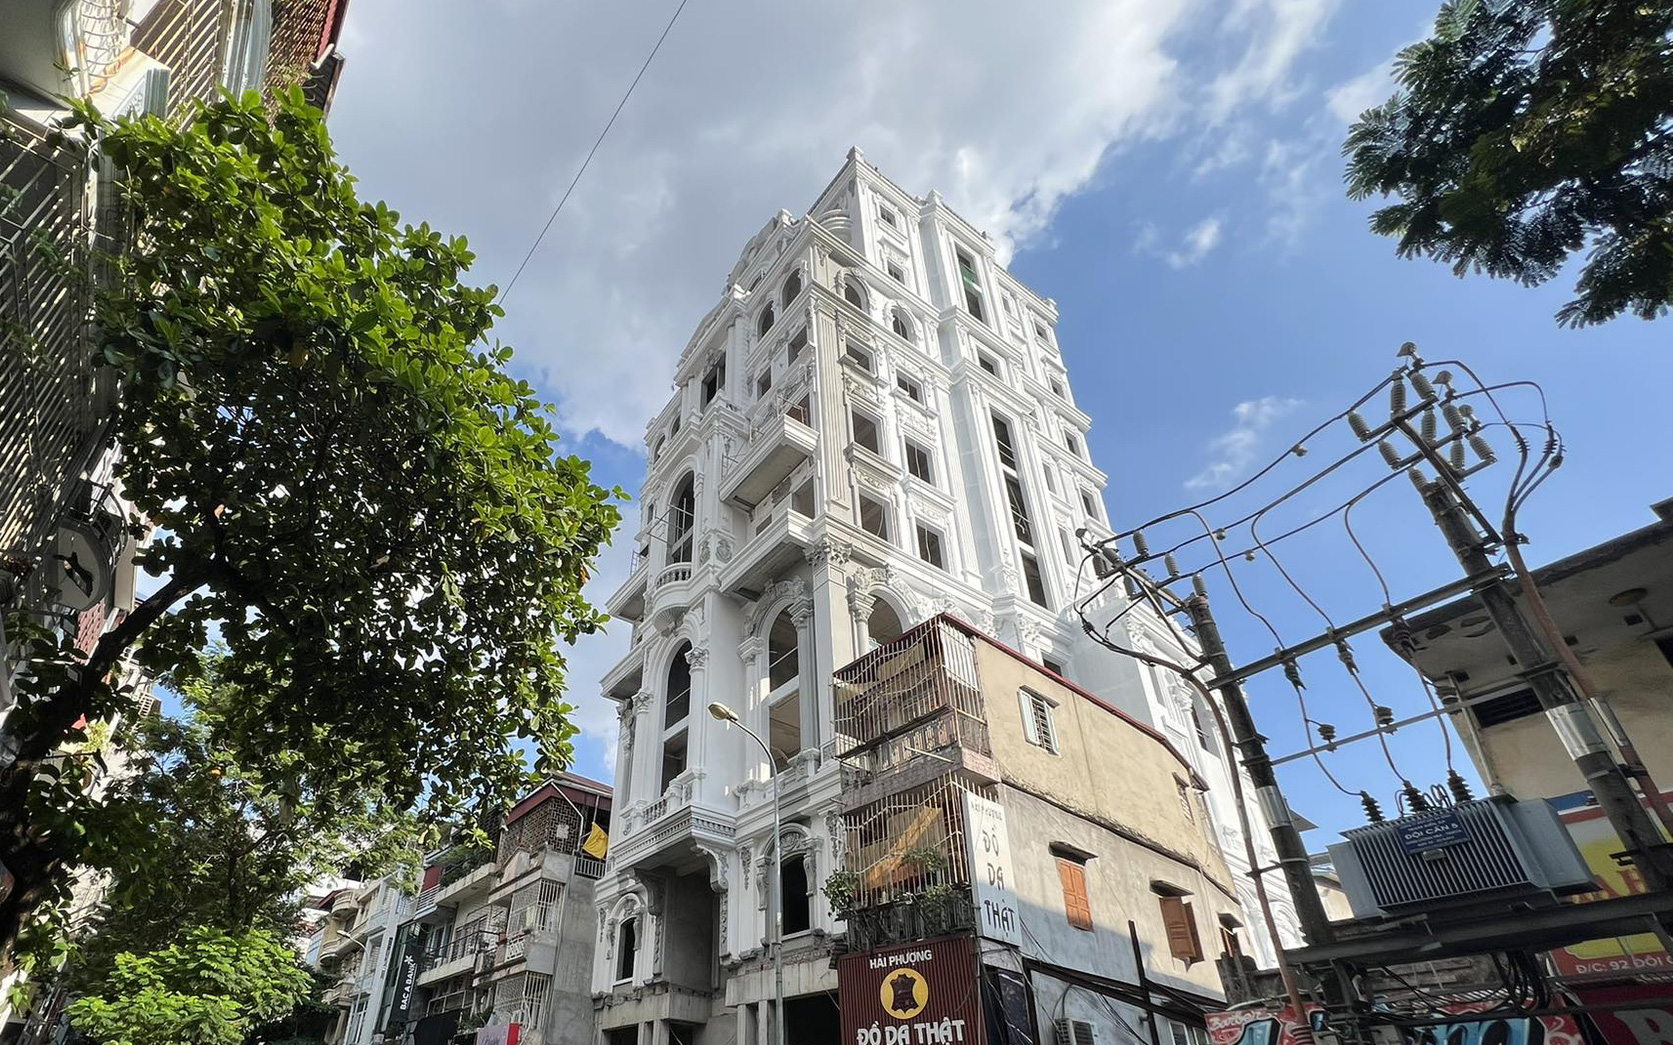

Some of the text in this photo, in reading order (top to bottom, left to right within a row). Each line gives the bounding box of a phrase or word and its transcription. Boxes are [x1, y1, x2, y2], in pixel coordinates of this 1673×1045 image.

[869, 949, 933, 969] HẢI PHƯỢNG
[1609, 960, 1631, 971] 92
[857, 1020, 882, 1045] ĐỒ
[913, 1016, 965, 1045] THẬT
